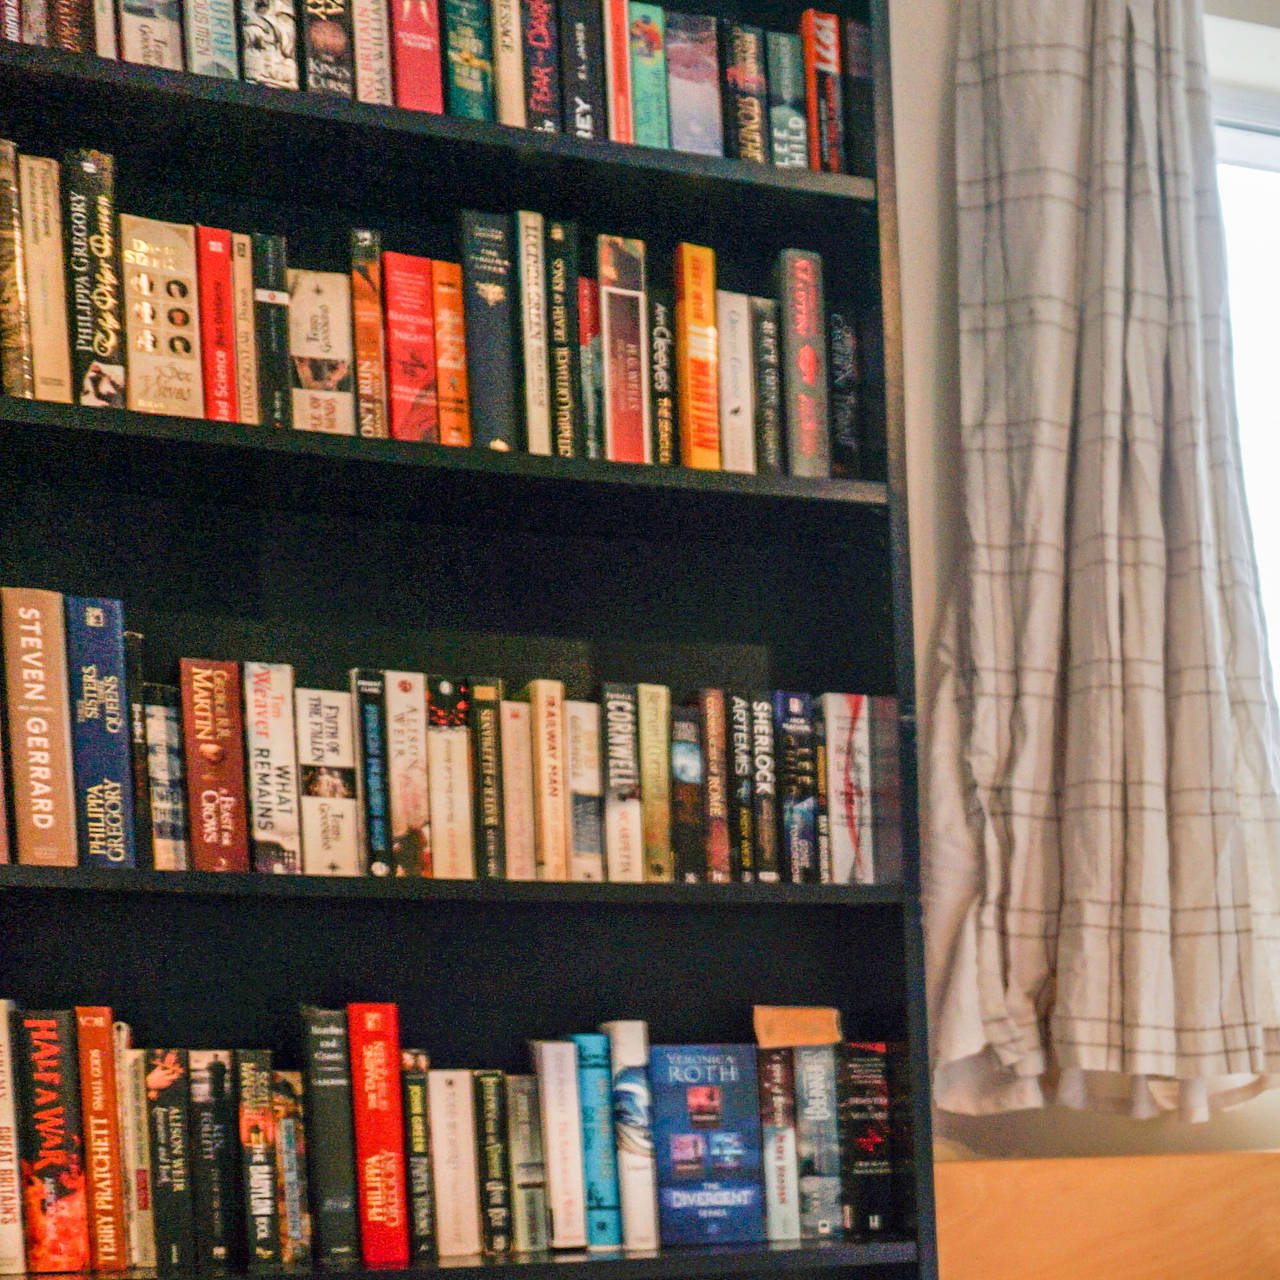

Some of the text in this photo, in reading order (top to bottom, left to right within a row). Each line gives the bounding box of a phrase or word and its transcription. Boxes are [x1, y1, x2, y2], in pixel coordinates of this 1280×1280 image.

[787, 116, 807, 169] HILD
[69, 191, 94, 352] PHILIPPA GREGORY
[213, 351, 228, 398] Science
[653, 326, 671, 392] Cleeves
[359, 398, 376, 438] ON'T
[18, 606, 54, 830] STEVEN GERRARD
[104, 674, 123, 734] QUEENS
[192, 666, 214, 741] MARTIN
[252, 669, 272, 740] Weaver
[308, 696, 325, 763] THE FALLEN
[324, 705, 340, 738] FAITH
[393, 713, 407, 760] WEIR
[731, 695, 751, 777] ARTEMIS
[405, 706, 420, 770] ALISON
[606, 700, 635, 788] CORNWELL
[751, 700, 775, 795] SHERLOCK
[796, 747, 813, 786] LEE
[86, 782, 107, 855] PHILIPPA
[103, 777, 125, 862] GREGORY
[201, 789, 219, 843] CROWS
[254, 747, 275, 832] REMAINS
[274, 764, 293, 815] WHAT
[23, 1018, 68, 1172] HALF A WAR
[668, 1065, 740, 1083] ROTH
[89, 1115, 114, 1210] PRATCHETT
[168, 1106, 186, 1193] ALISON WEIR
[365, 1154, 384, 1222] PHILIPPA
[670, 1190, 757, 1208] DIVERGENT
[97, 1213, 118, 1262] TERRY
